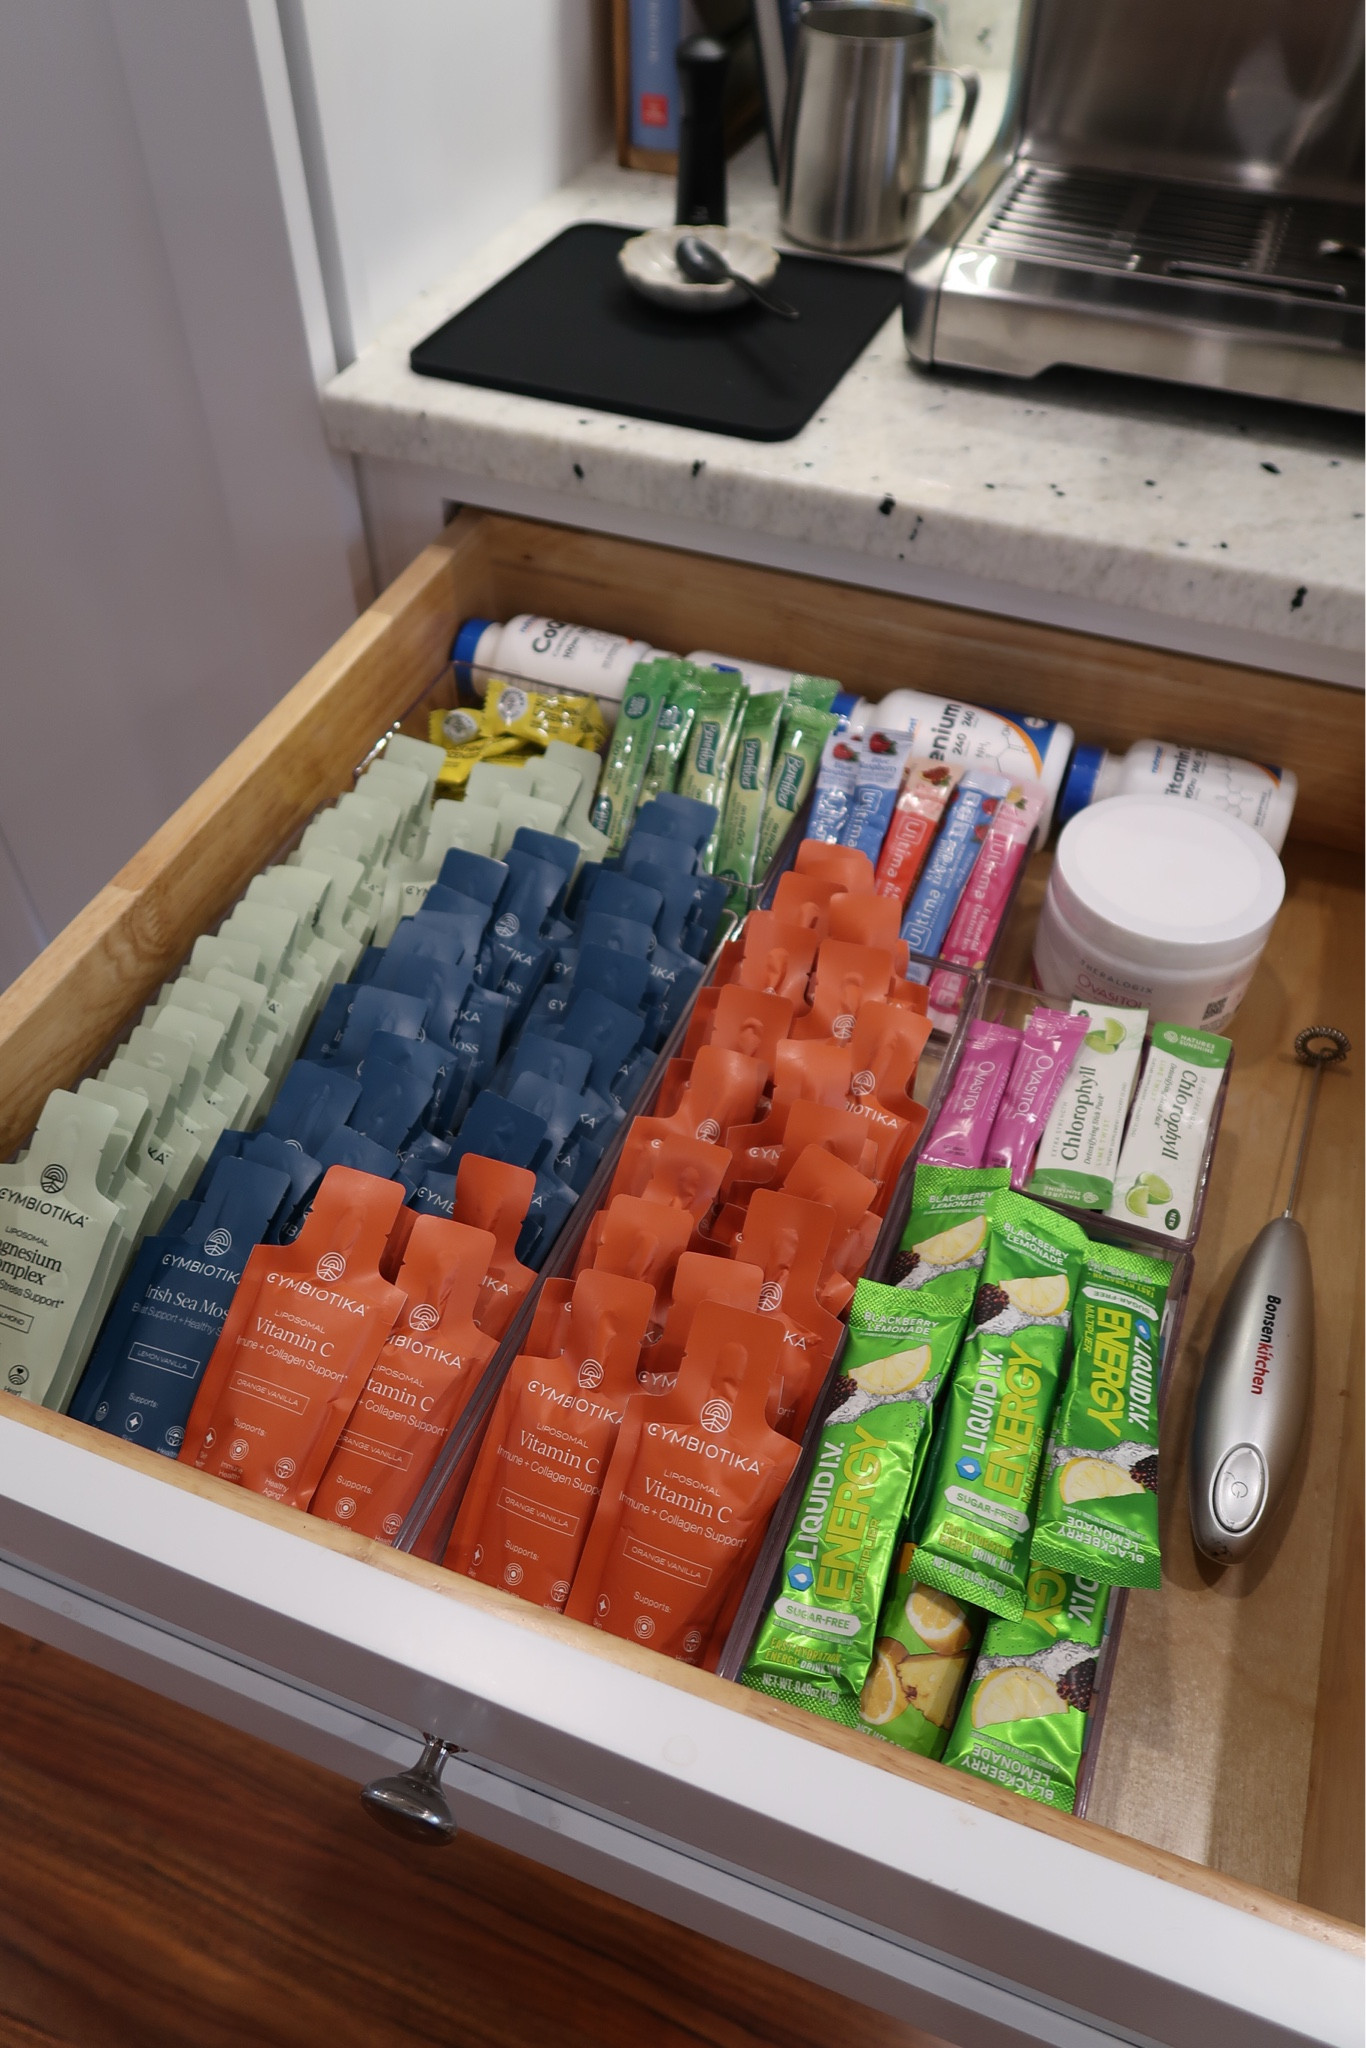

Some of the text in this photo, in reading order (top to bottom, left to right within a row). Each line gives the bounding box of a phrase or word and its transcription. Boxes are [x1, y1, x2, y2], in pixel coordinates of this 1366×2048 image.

[699, 723, 719, 774] Benefiber
[929, 703, 961, 761] enium
[953, 733, 967, 755] 240
[740, 739, 759, 789] Benefiber
[777, 754, 803, 810] Benefiber
[887, 820, 921, 879] Ultima
[909, 889, 940, 946] Ultima
[960, 1061, 995, 1114] OVASITOL
[1012, 1055, 1054, 1119] OVASITOL
[846, 1101, 898, 1129] IOTIKA
[1061, 1066, 1098, 1161] Chlorophyll
[1160, 1070, 1198, 1160] Chlorophyll
[1084, 1125, 1099, 1165] Detoxifying
[0, 1187, 84, 1228] CYMBIOTIKA
[929, 1191, 993, 1203] BLACKBERRY
[931, 1199, 985, 1210] LEMONADE
[1169, 1211, 1177, 1228] NEW
[5, 1225, 49, 1248] LIPOSOMAL
[1004, 1222, 1069, 1259] BLACKBERRY
[1006, 1233, 1064, 1266] LEMONADE
[0, 1241, 62, 1272] gnesium
[162, 1253, 241, 1285] CYMBIOTIK
[145, 1284, 229, 1320] Irish Sea Mos
[266, 1272, 366, 1317] CYMBIOTIKA
[1093, 1290, 1151, 1314] SUGAR-FREE
[0, 1312, 25, 1326] LMOND
[148, 1306, 178, 1322] Support
[184, 1318, 215, 1335] Healthy
[274, 1310, 326, 1334] LIPOSOMAL
[863, 1311, 940, 1328] BLACKBERRY
[867, 1323, 931, 1335] LEMONADE
[1083, 1303, 1095, 1353] MULTIPLIER
[256, 1316, 335, 1358] Vitamin C
[390, 1334, 462, 1369] BIOTIKA
[1250, 1294, 1281, 1396] Bonsenkitchen
[137, 1350, 187, 1370] LEMON VANILLA
[265, 1344, 306, 1368] Collagen
[1087, 1307, 1132, 1437] ENERGY
[128, 1392, 158, 1408] Supports:
[236, 1378, 299, 1406] ORANGE VANILLA
[367, 1377, 435, 1412] tamin C
[1128, 1336, 1152, 1431] LIQUID I.V.
[365, 1399, 407, 1422] Collagen
[962, 1349, 1004, 1455] LIQUID I.V.
[233, 1417, 267, 1437] Supports:
[536, 1422, 589, 1449] LIPOSOMAL
[984, 1341, 1042, 1499] ENERGY
[371, 1447, 403, 1462] VANILLA
[520, 1429, 600, 1474] Vitamin C
[647, 1423, 760, 1475] CYMBIOTIKA
[1021, 1427, 1045, 1503] MULTIPLIER
[264, 1478, 289, 1492] Healthy
[336, 1474, 373, 1495] Supports:
[530, 1461, 571, 1486] Collagen
[663, 1469, 721, 1497] LIPOSOMAL
[504, 1496, 569, 1528] ORANGE VANILLA
[644, 1476, 733, 1523] Vitamin C
[795, 1441, 846, 1560] LIQUID I.V.
[815, 1424, 888, 1601] ENERGY
[957, 1492, 1019, 1525] SUGAR-FREE
[659, 1509, 704, 1535] Collagen
[1066, 1515, 1139, 1552] LEMONADE
[504, 1539, 540, 1561] Supports:
[852, 1517, 880, 1603] MULTIPLIER
[972, 1547, 998, 1566] DRINK
[998, 1559, 1015, 1574] MIX
[1057, 1525, 1145, 1564] BLACKBERRY
[631, 1546, 702, 1579] ORANGE VANILLA
[633, 1591, 672, 1613] Supports:
[786, 1605, 850, 1630] SUGAR-FREE
[1067, 1591, 1096, 1627] I.V.
[765, 1650, 799, 1666] ENERGY
[800, 1660, 825, 1674] DRINK
[762, 1673, 779, 1687] NET
[961, 1755, 1055, 1800] BLACKBERRY
[972, 1742, 1050, 1786] LEMONADE
